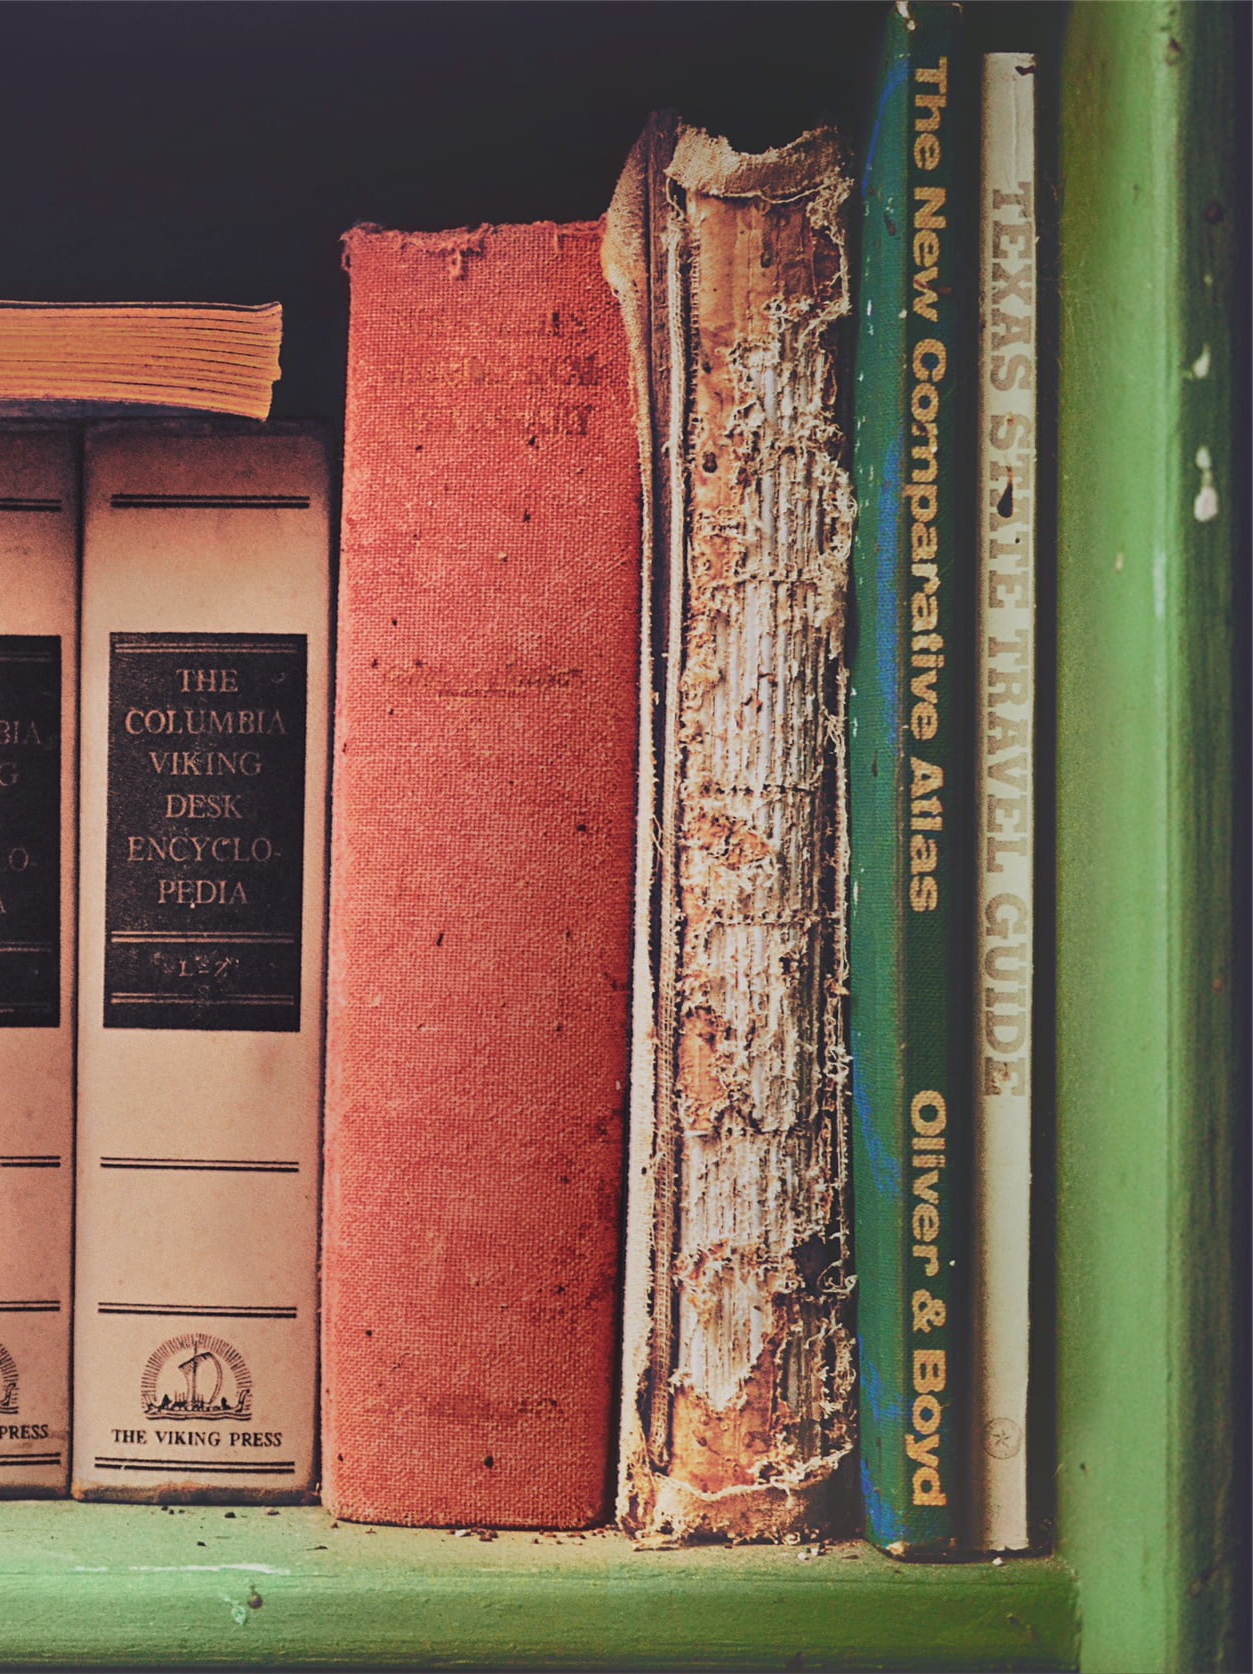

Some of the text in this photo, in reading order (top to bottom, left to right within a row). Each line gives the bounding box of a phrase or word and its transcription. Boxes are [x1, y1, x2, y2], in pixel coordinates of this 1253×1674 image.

[901, 56, 948, 913] The New Comparative Atlas
[984, 182, 1031, 1097] TEXAS STATE TRAVEL GUIDE
[176, 668, 239, 694] THE
[124, 708, 288, 736] COLUMBIA
[148, 750, 264, 777] VIKING
[164, 793, 243, 820] DESK
[126, 835, 282, 863] ENCYCLO-
[157, 878, 249, 905] PEDIA
[904, 1090, 946, 1506] Oliver & Boyd
[111, 1429, 283, 1448] THE VIKING PRESS
